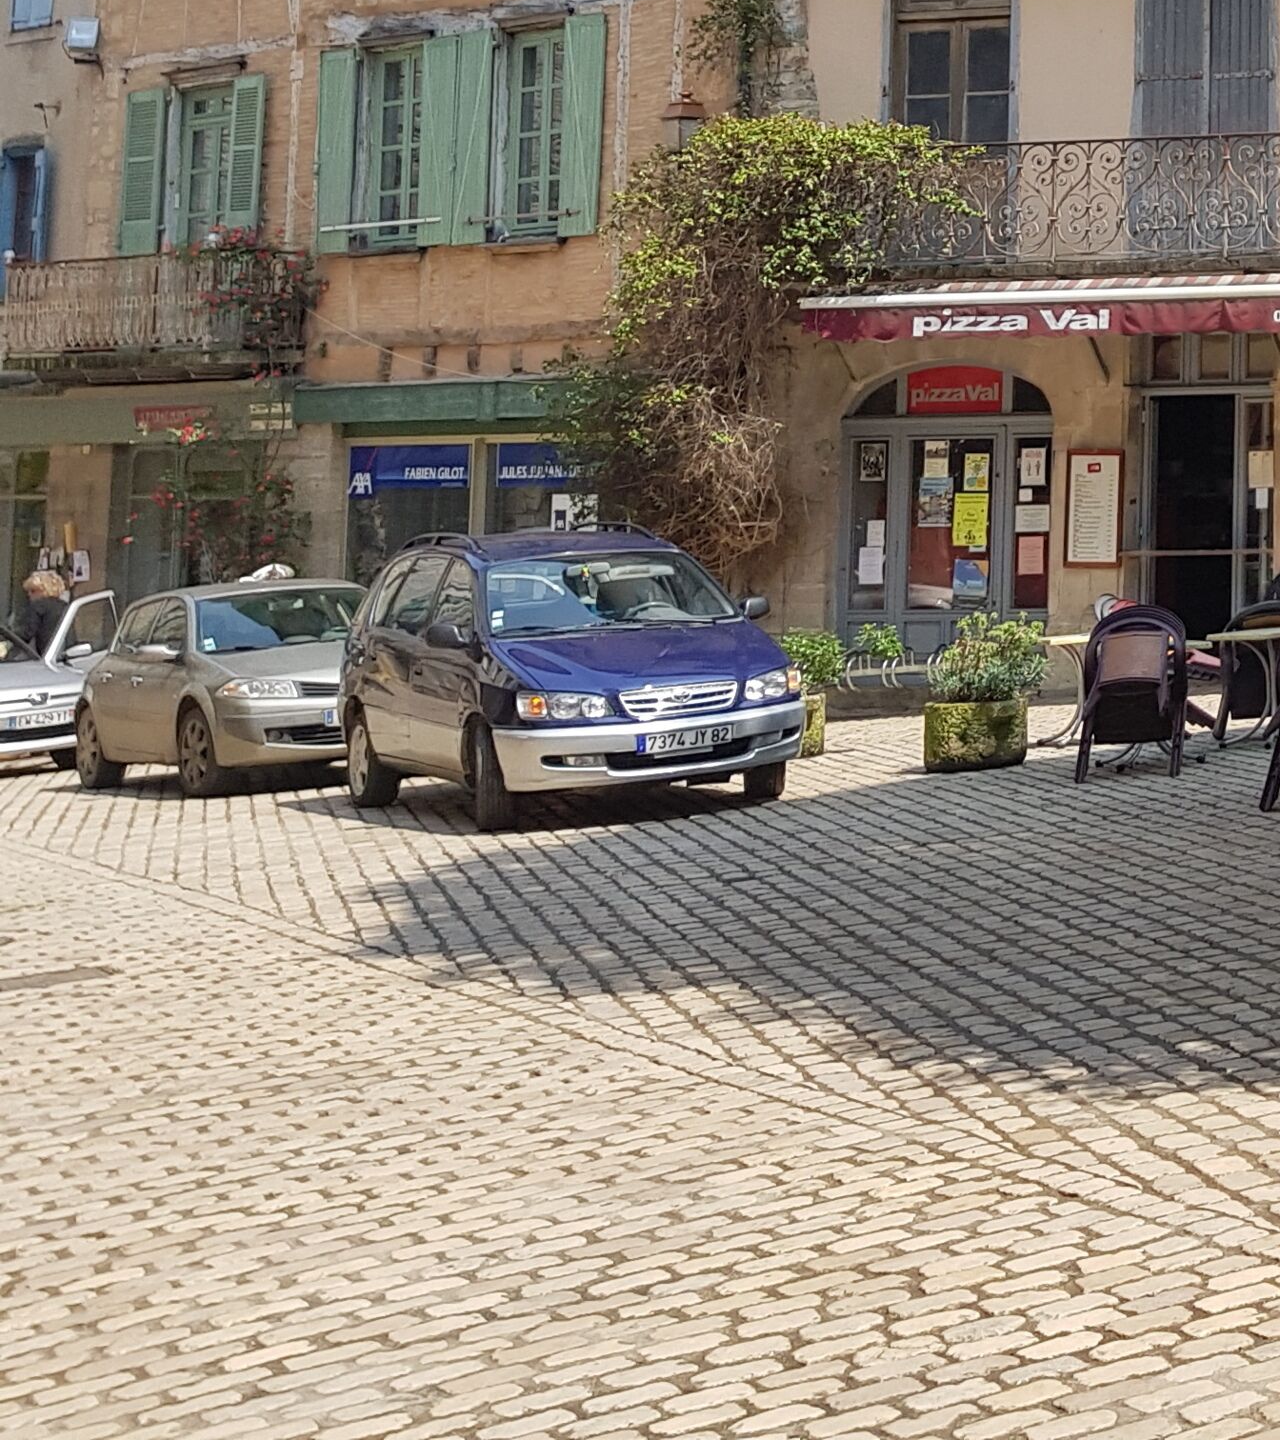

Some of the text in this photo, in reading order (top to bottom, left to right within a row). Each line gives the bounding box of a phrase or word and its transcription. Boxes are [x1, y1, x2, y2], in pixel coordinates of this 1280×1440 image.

[912, 308, 1110, 337] pizza Val
[347, 472, 373, 495] AXA
[404, 466, 465, 480] FABIEN GILOT
[500, 466, 527, 479] JULES
[648, 727, 729, 752] 7374 JY 82
